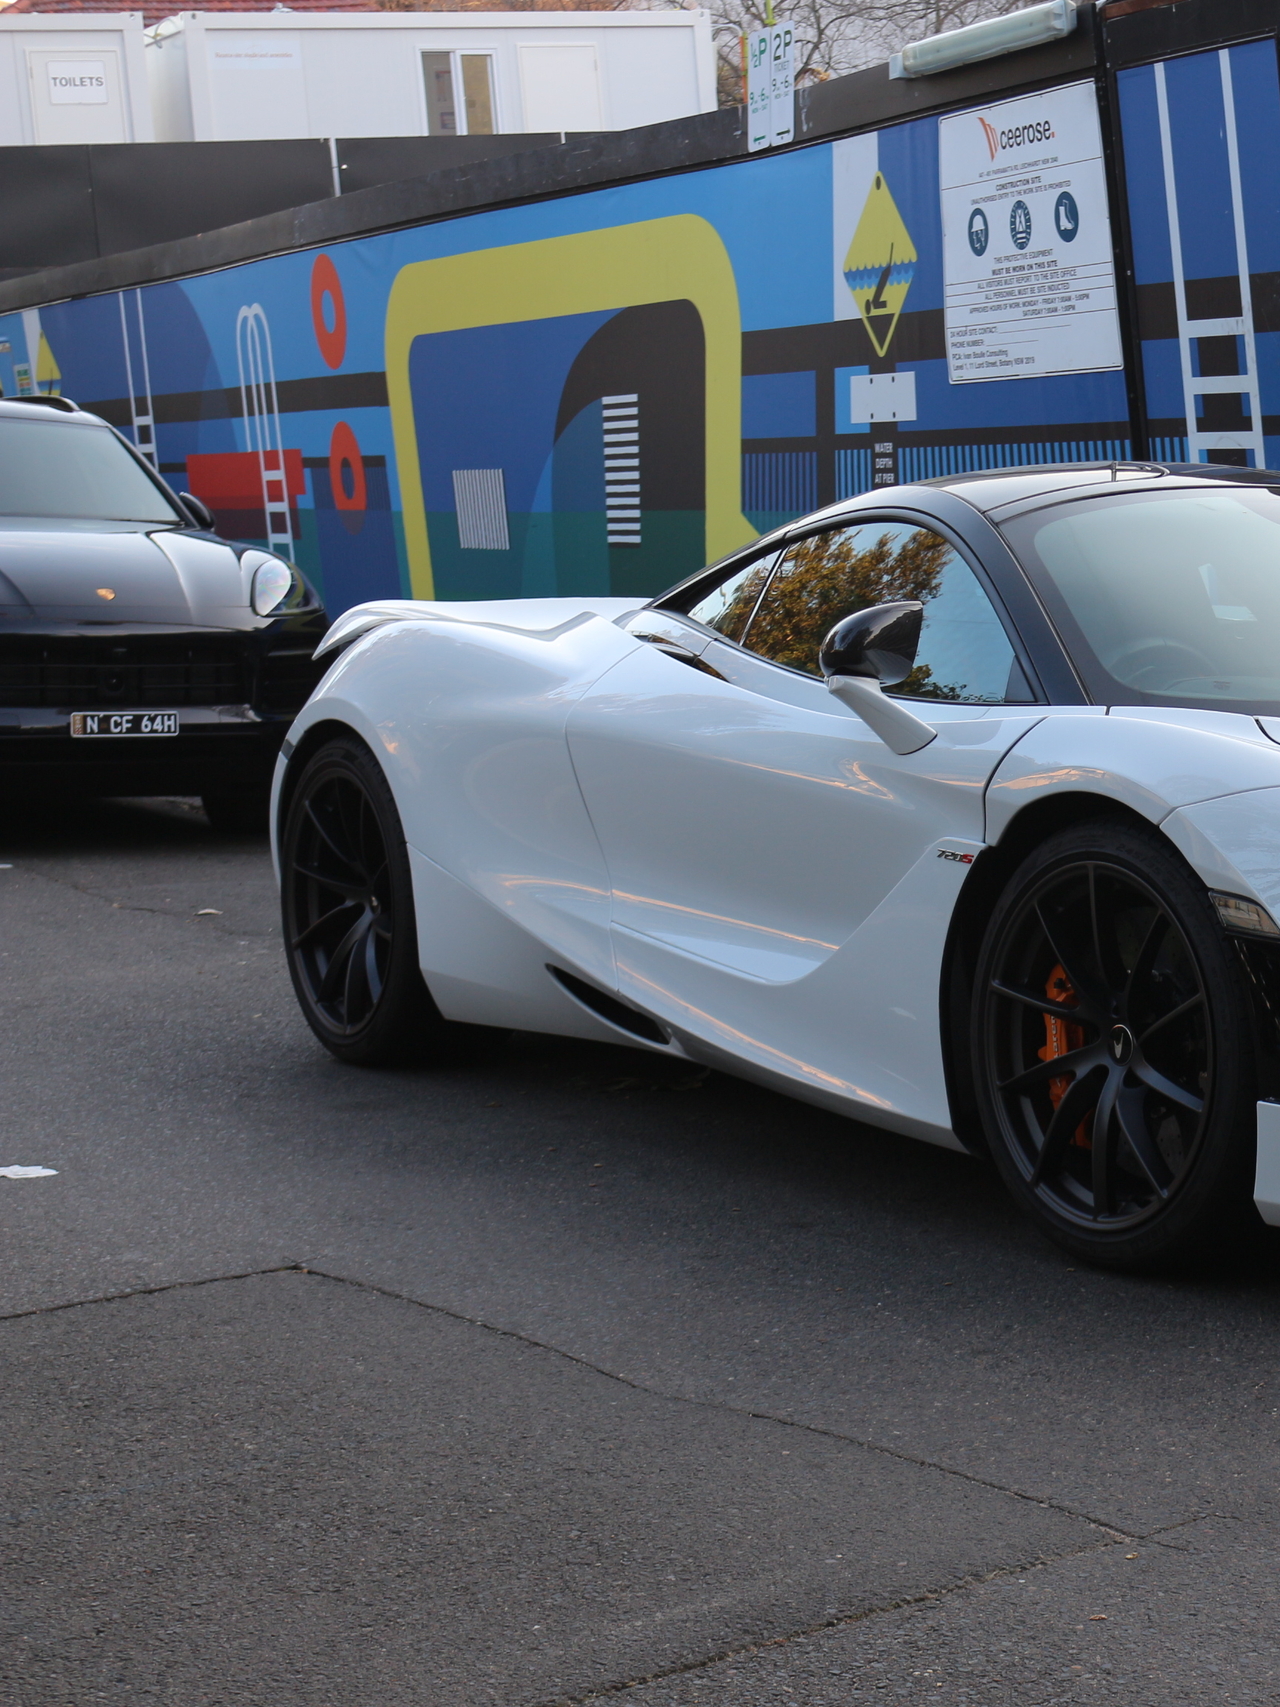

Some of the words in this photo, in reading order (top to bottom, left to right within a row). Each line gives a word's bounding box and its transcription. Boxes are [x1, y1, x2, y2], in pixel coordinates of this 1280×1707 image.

[773, 30, 792, 60] 2P
[51, 76, 104, 87] TOILETS
[996, 178, 1029, 191] CONSTRUCTION
[1030, 176, 1041, 184] SITE
[994, 256, 1002, 264] THIS
[1003, 253, 1027, 263] PROTECTIVE
[1028, 249, 1053, 259] EQUIPMENT
[992, 268, 1003, 276] MUST
[1012, 265, 1025, 273] WORN
[1034, 262, 1045, 270] THIS
[985, 279, 1003, 288] VISITORS
[1003, 278, 1014, 286] MUST
[1015, 276, 1032, 284] REPORT
[1034, 274, 1039, 282] TO
[1040, 273, 1048, 281] THE
[1049, 272, 1059, 280] SITE
[1060, 270, 1077, 278] OFFICE
[992, 290, 1016, 299] PERSONNEL
[1017, 288, 1028, 296] MUST
[1037, 286, 1046, 294] SITE
[1047, 283, 1069, 292] INDUCTED
[874, 442, 893, 453] WATER
[876, 458, 893, 468] DEPTH
[875, 473, 882, 483] AT
[883, 473, 894, 483] PIER
[86, 716, 98, 733] N
[110, 715, 133, 732] CF
[141, 715, 175, 732] 64H
[937, 848, 974, 864] 720S
